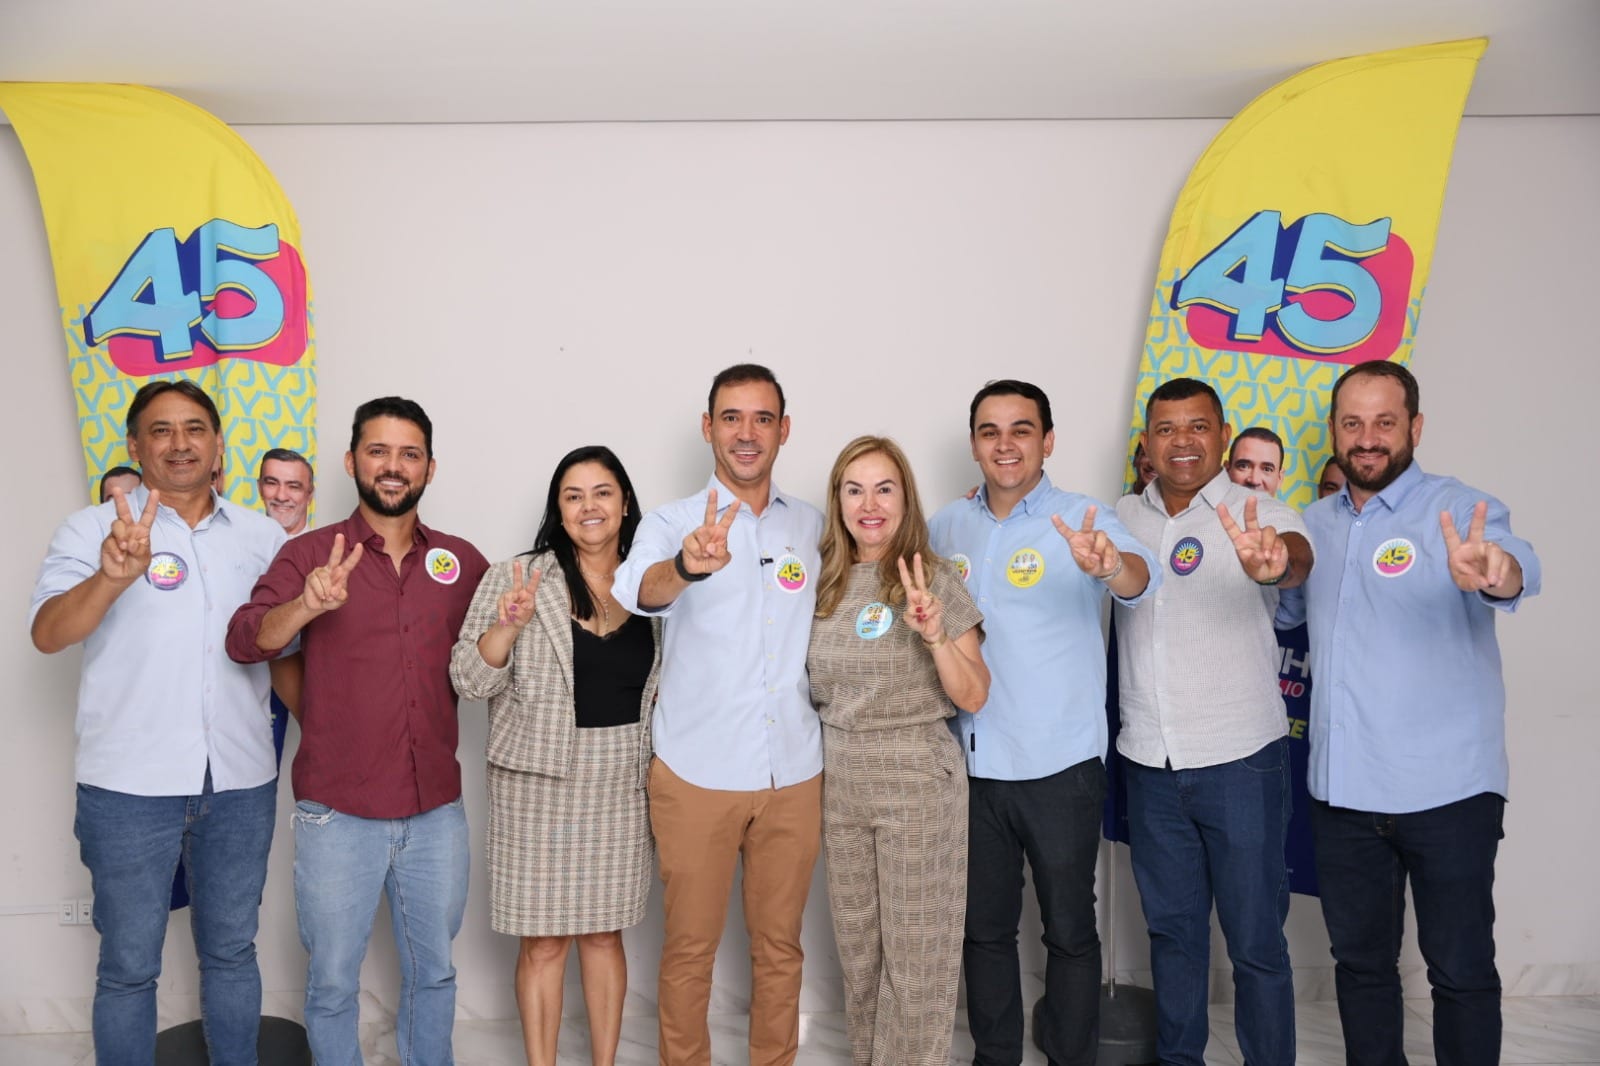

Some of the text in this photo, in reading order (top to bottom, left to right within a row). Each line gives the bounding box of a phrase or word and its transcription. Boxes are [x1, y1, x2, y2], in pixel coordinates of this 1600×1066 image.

[83, 218, 285, 363] 45
[1171, 210, 1392, 356] 45
[433, 552, 456, 577] 45
[1175, 548, 1200, 564] 45
[1377, 546, 1411, 567] 45
[150, 562, 178, 579] 45
[777, 563, 805, 583] 45
